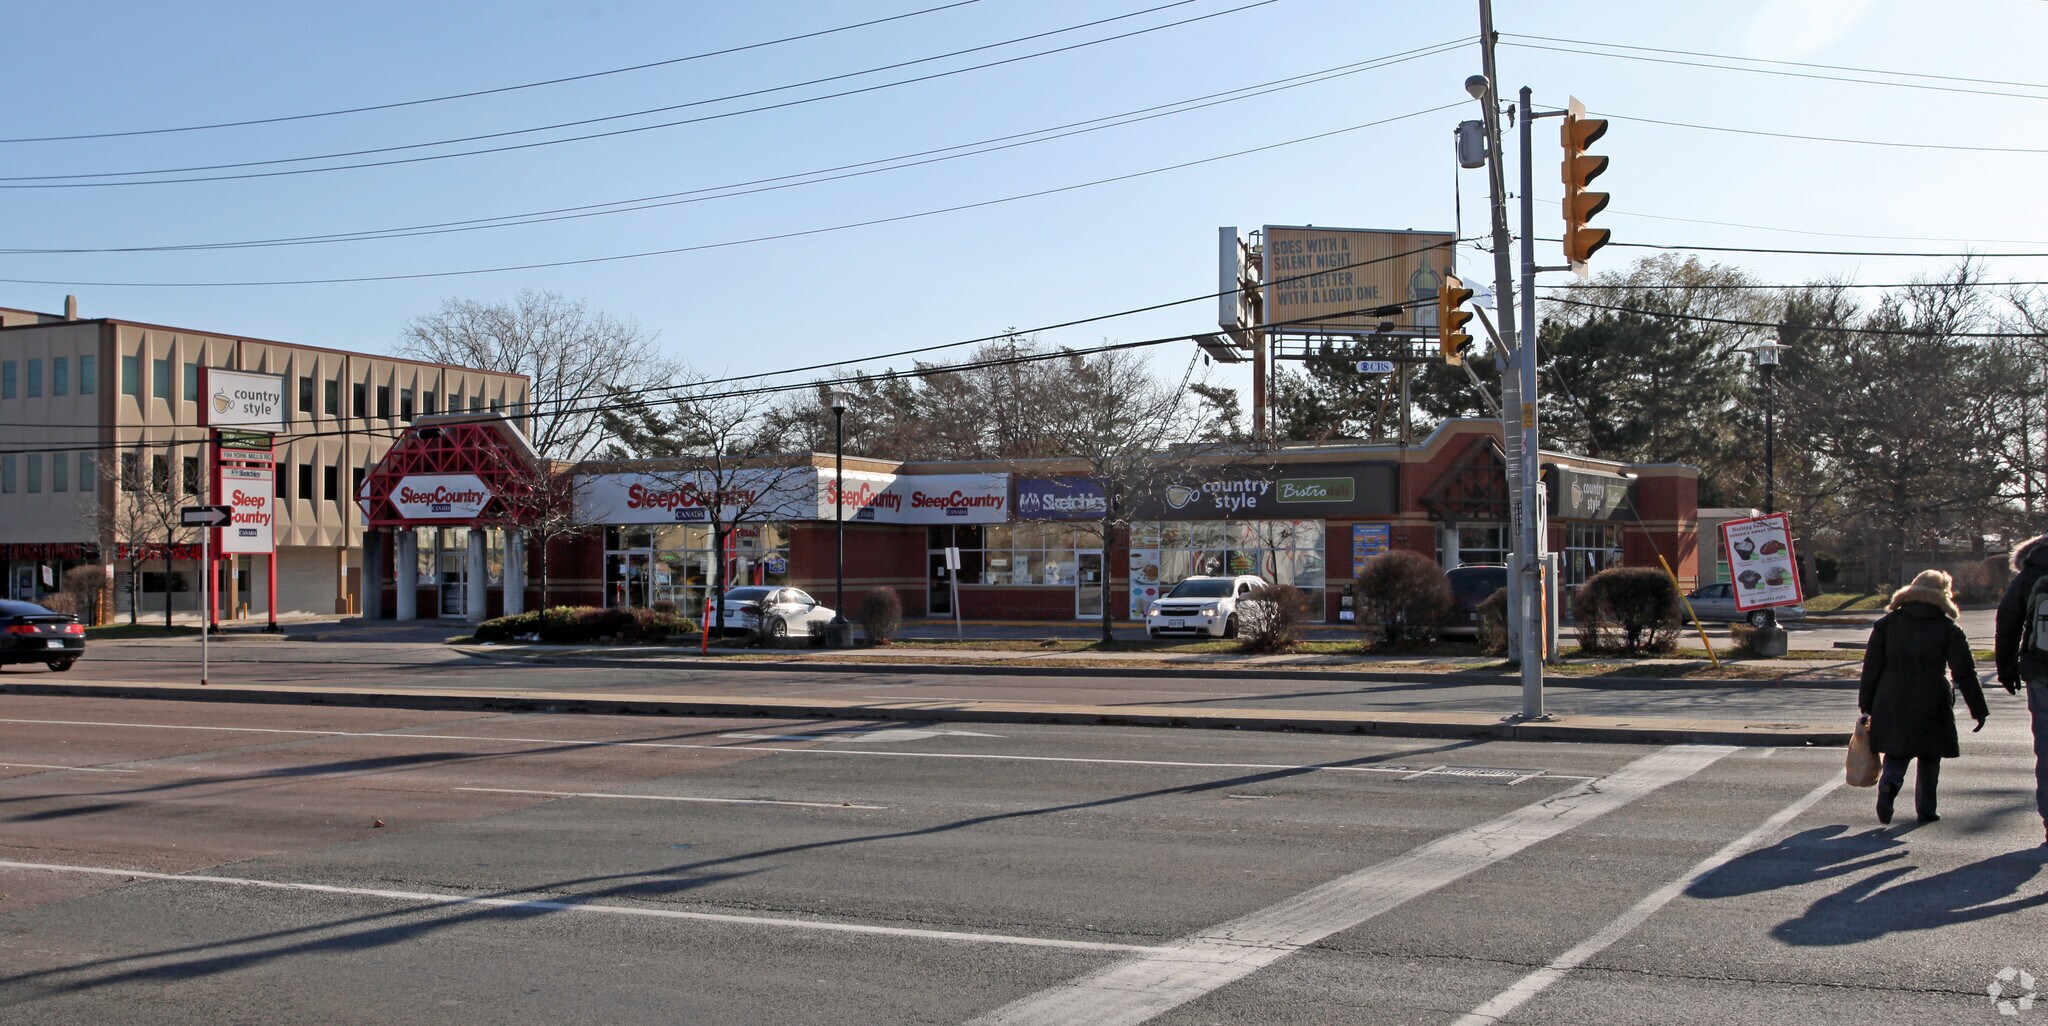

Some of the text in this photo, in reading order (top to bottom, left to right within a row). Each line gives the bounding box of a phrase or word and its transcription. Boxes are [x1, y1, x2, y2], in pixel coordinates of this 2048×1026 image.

[1272, 237, 1349, 255] GOES WITH A
[1274, 252, 1352, 271] SILENT NIGHT
[1276, 272, 1353, 290] GOES BETTER
[1278, 286, 1382, 305] WITH A LOUD ONE.
[1370, 362, 1389, 371] CBS
[234, 388, 280, 404] country
[243, 402, 272, 417] style
[400, 486, 484, 506] SleepCountry
[827, 479, 902, 512] SeepCountry
[1202, 478, 1269, 496] country
[1282, 482, 1349, 498] Bistro deli
[1584, 482, 1605, 499] country
[232, 489, 265, 510] Sleep
[911, 490, 1005, 510] SleepCountry
[1215, 492, 1257, 512] style
[1587, 496, 1601, 513] style
[676, 510, 704, 519] CANADA
